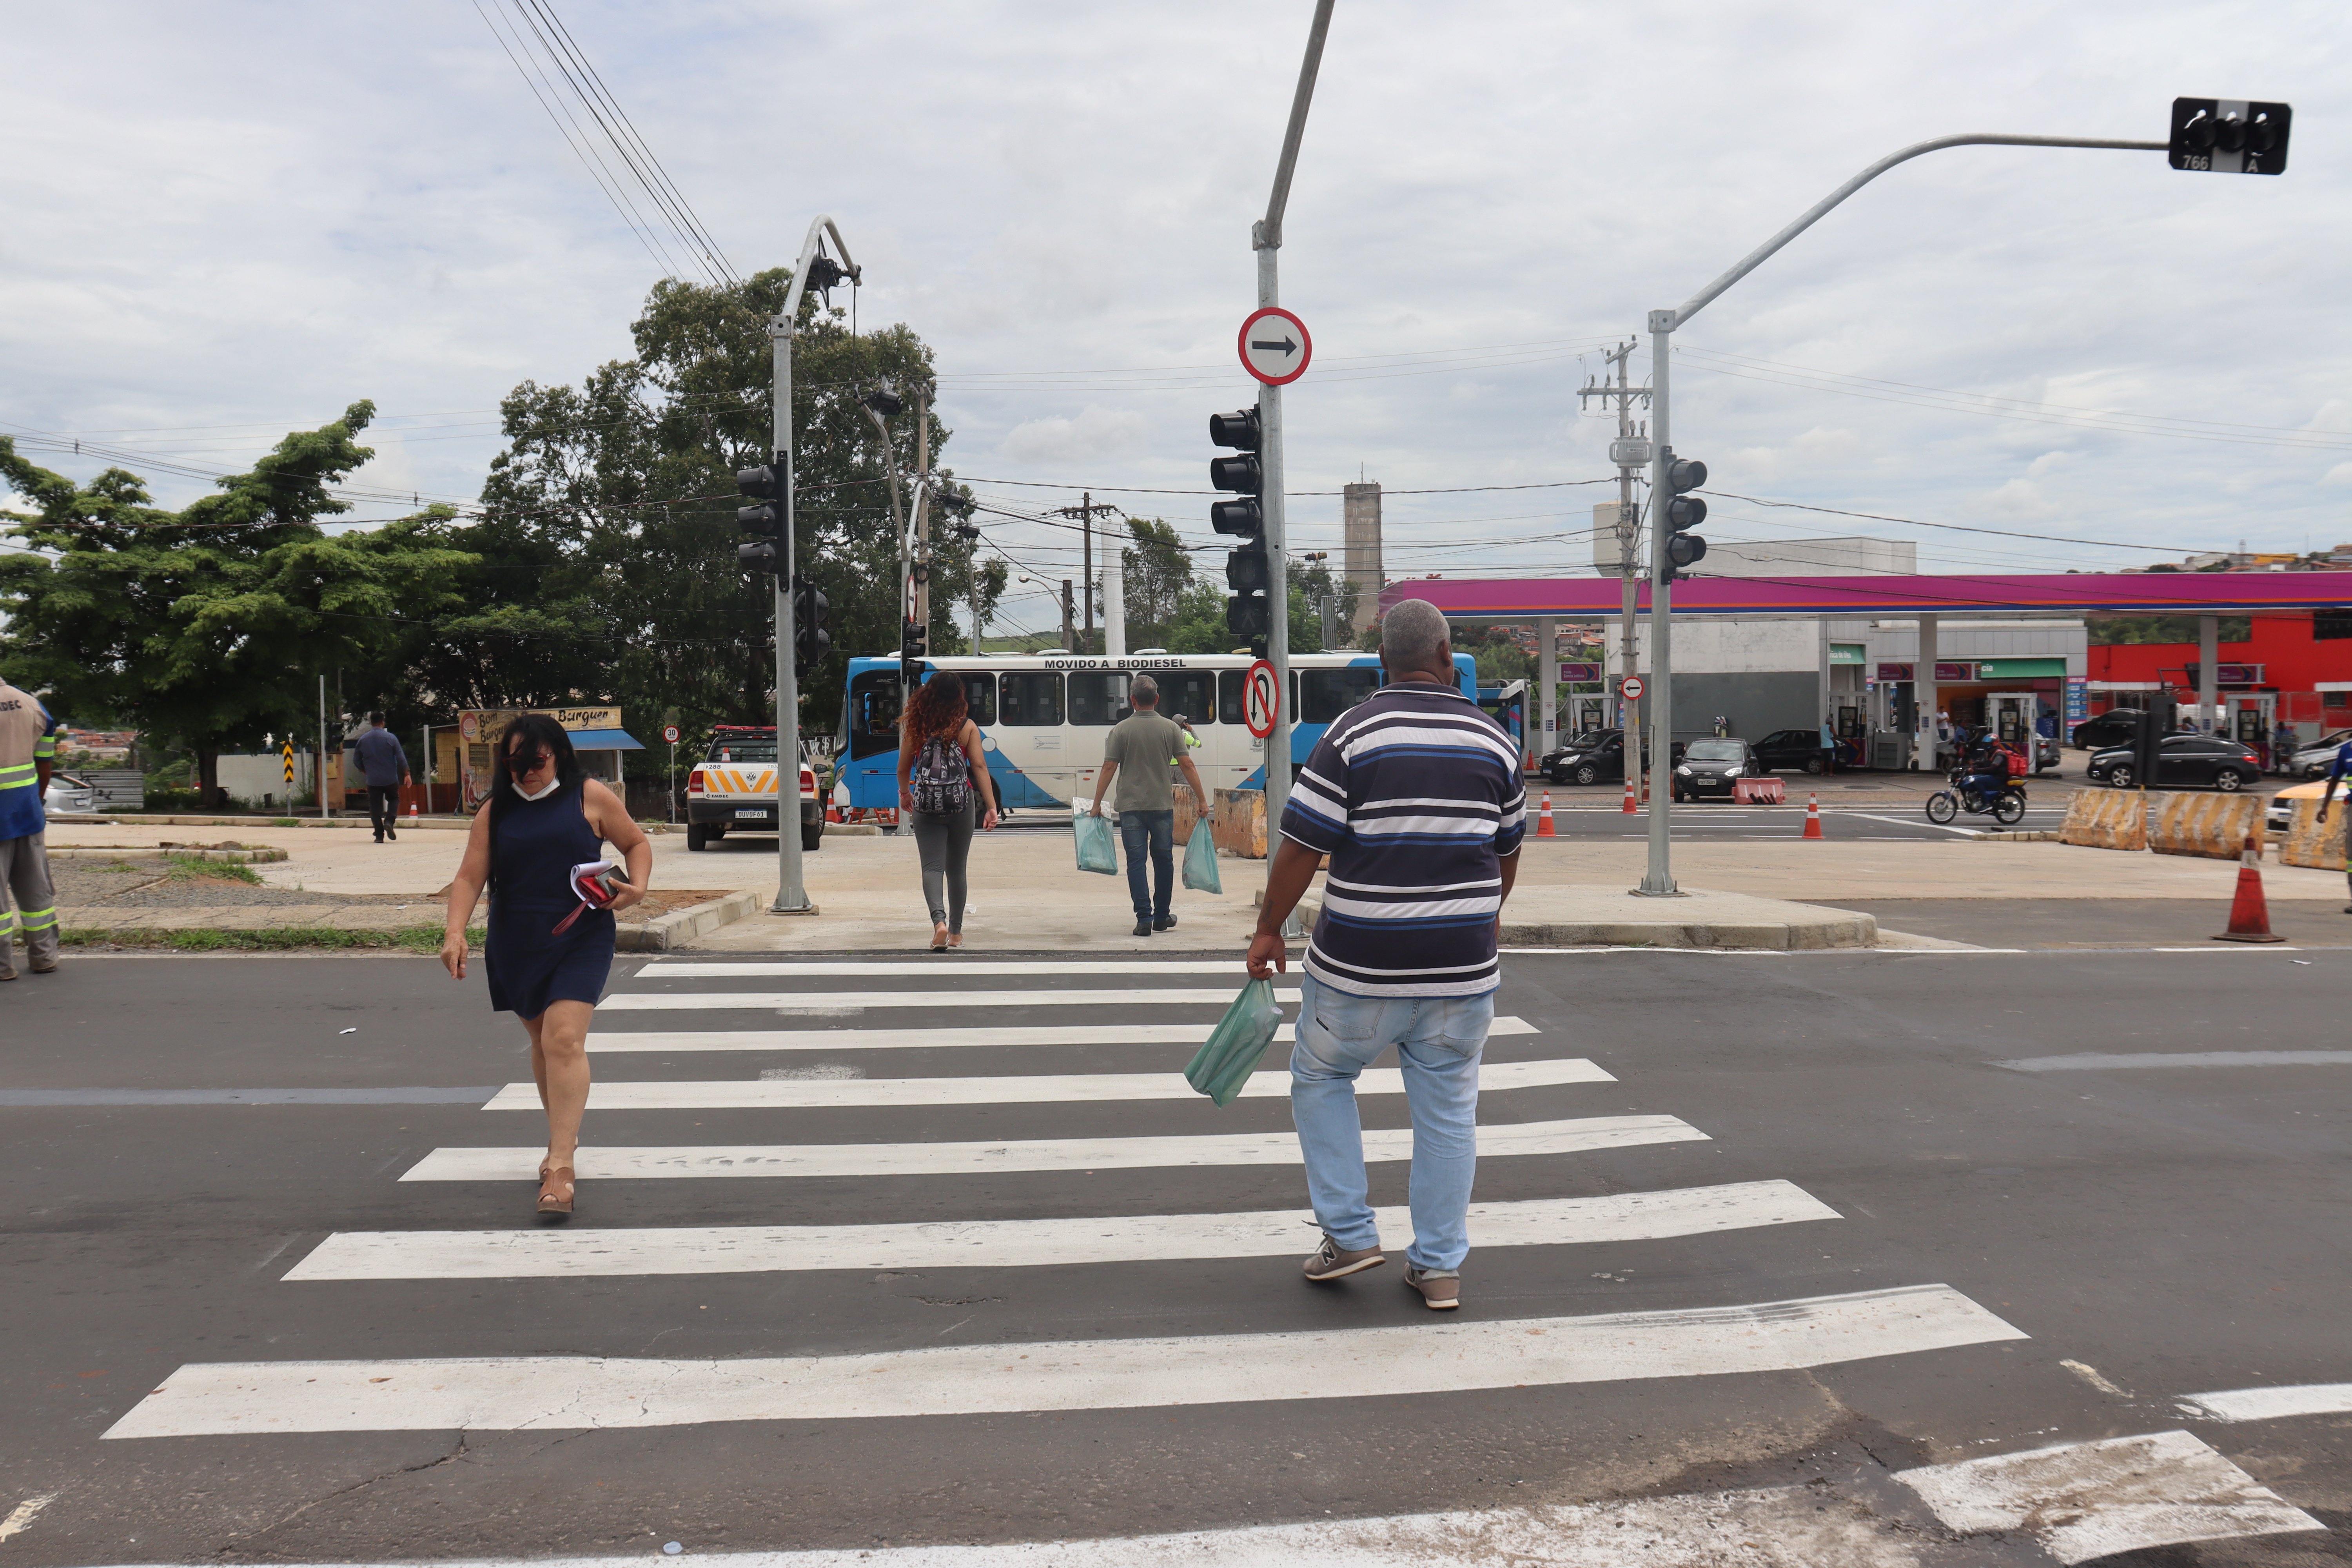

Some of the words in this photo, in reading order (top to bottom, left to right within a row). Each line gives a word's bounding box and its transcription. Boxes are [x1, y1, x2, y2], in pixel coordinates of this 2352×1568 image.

[2182, 155, 2209, 170] 766
[2246, 158, 2259, 172] A
[1045, 660, 1096, 668] MOVIDO
[1101, 660, 1109, 668] A
[1118, 659, 1187, 668] BIODIESEL
[0, 699, 22, 711] DEC
[478, 712, 497, 728] Bom
[480, 725, 506, 743] Burgu
